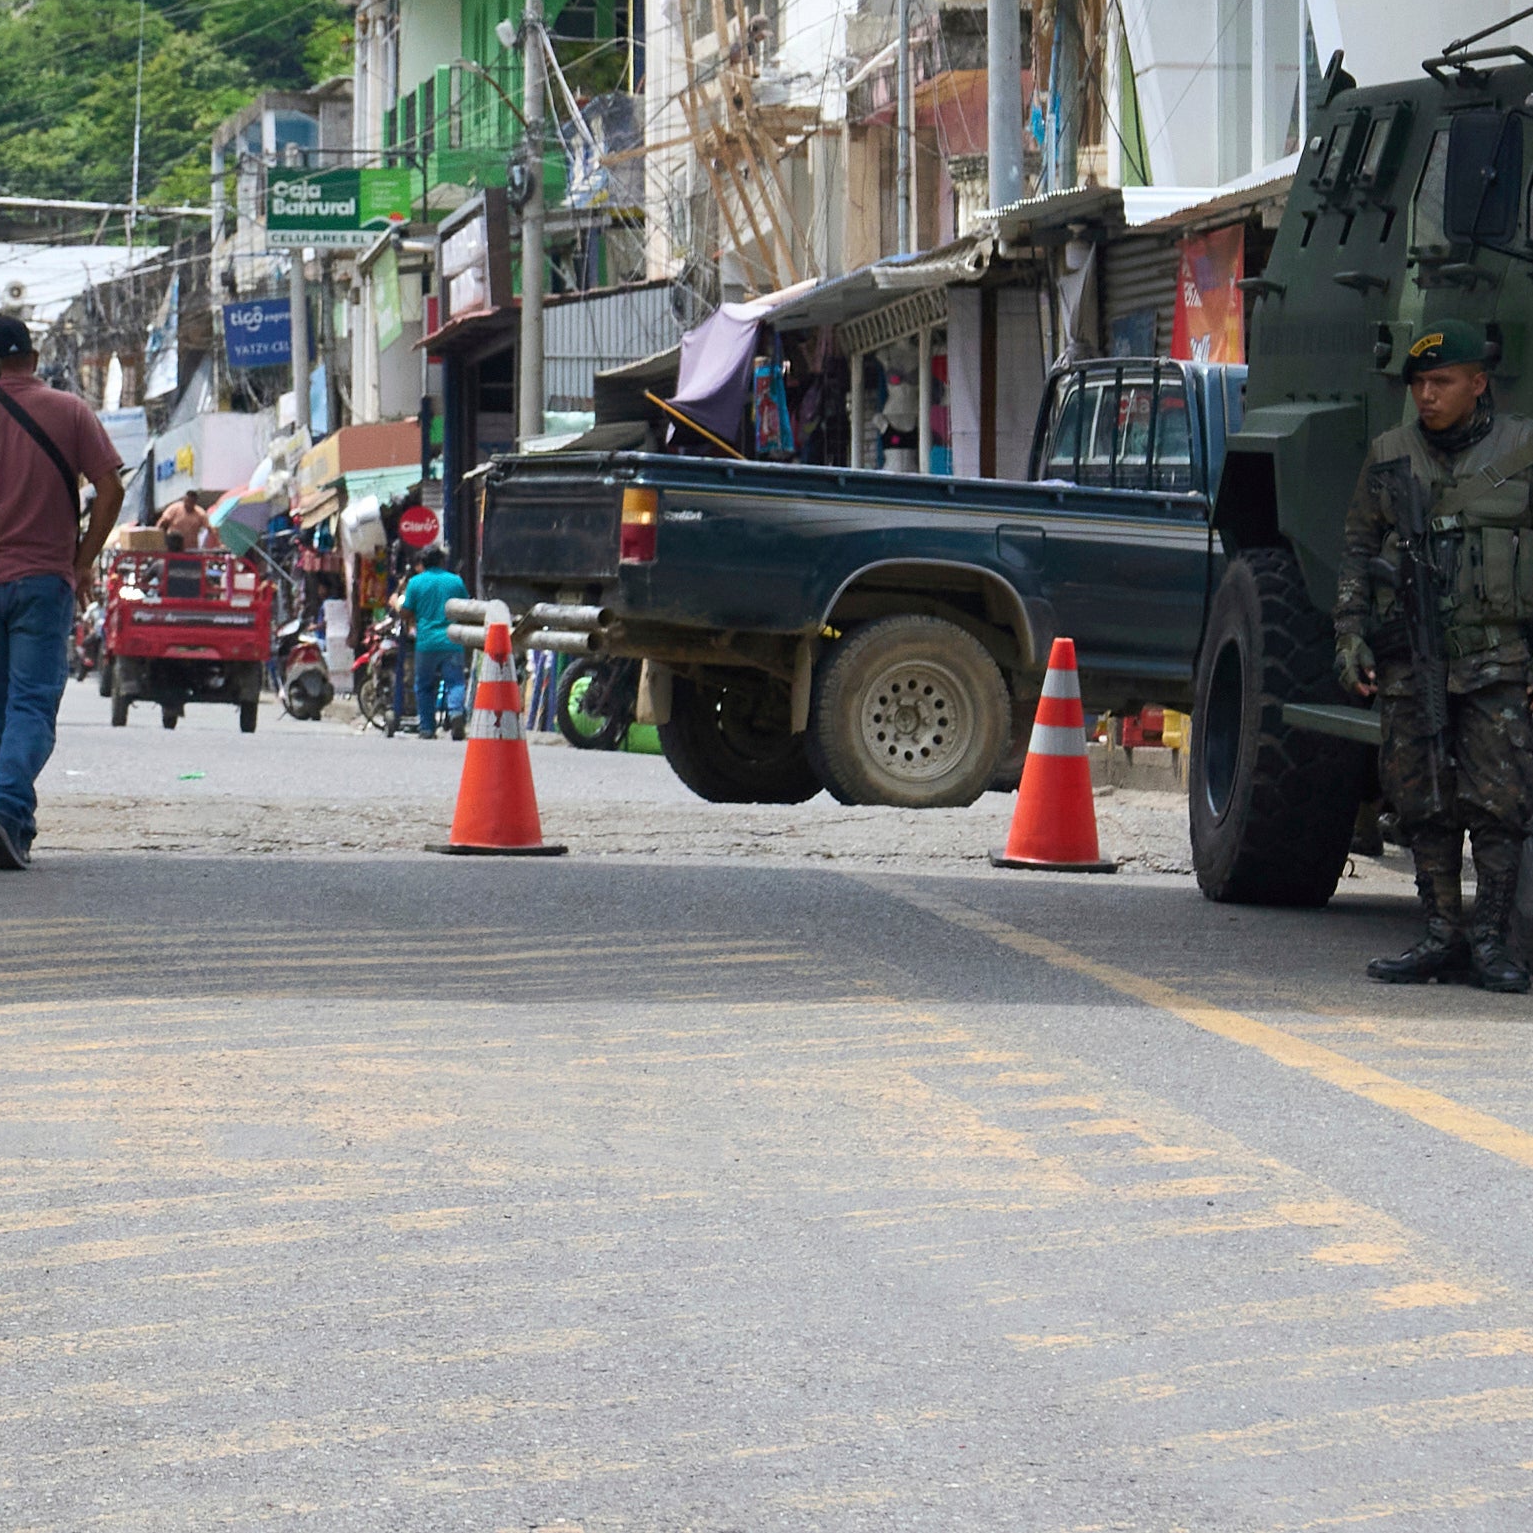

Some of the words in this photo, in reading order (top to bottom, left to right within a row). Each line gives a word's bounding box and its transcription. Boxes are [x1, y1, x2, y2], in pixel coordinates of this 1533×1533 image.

[272, 178, 322, 201] Caja
[272, 197, 356, 216] Banrural
[271, 234, 347, 244] CELULARES
[230, 305, 264, 332] tigo
[401, 519, 433, 533] Claro
